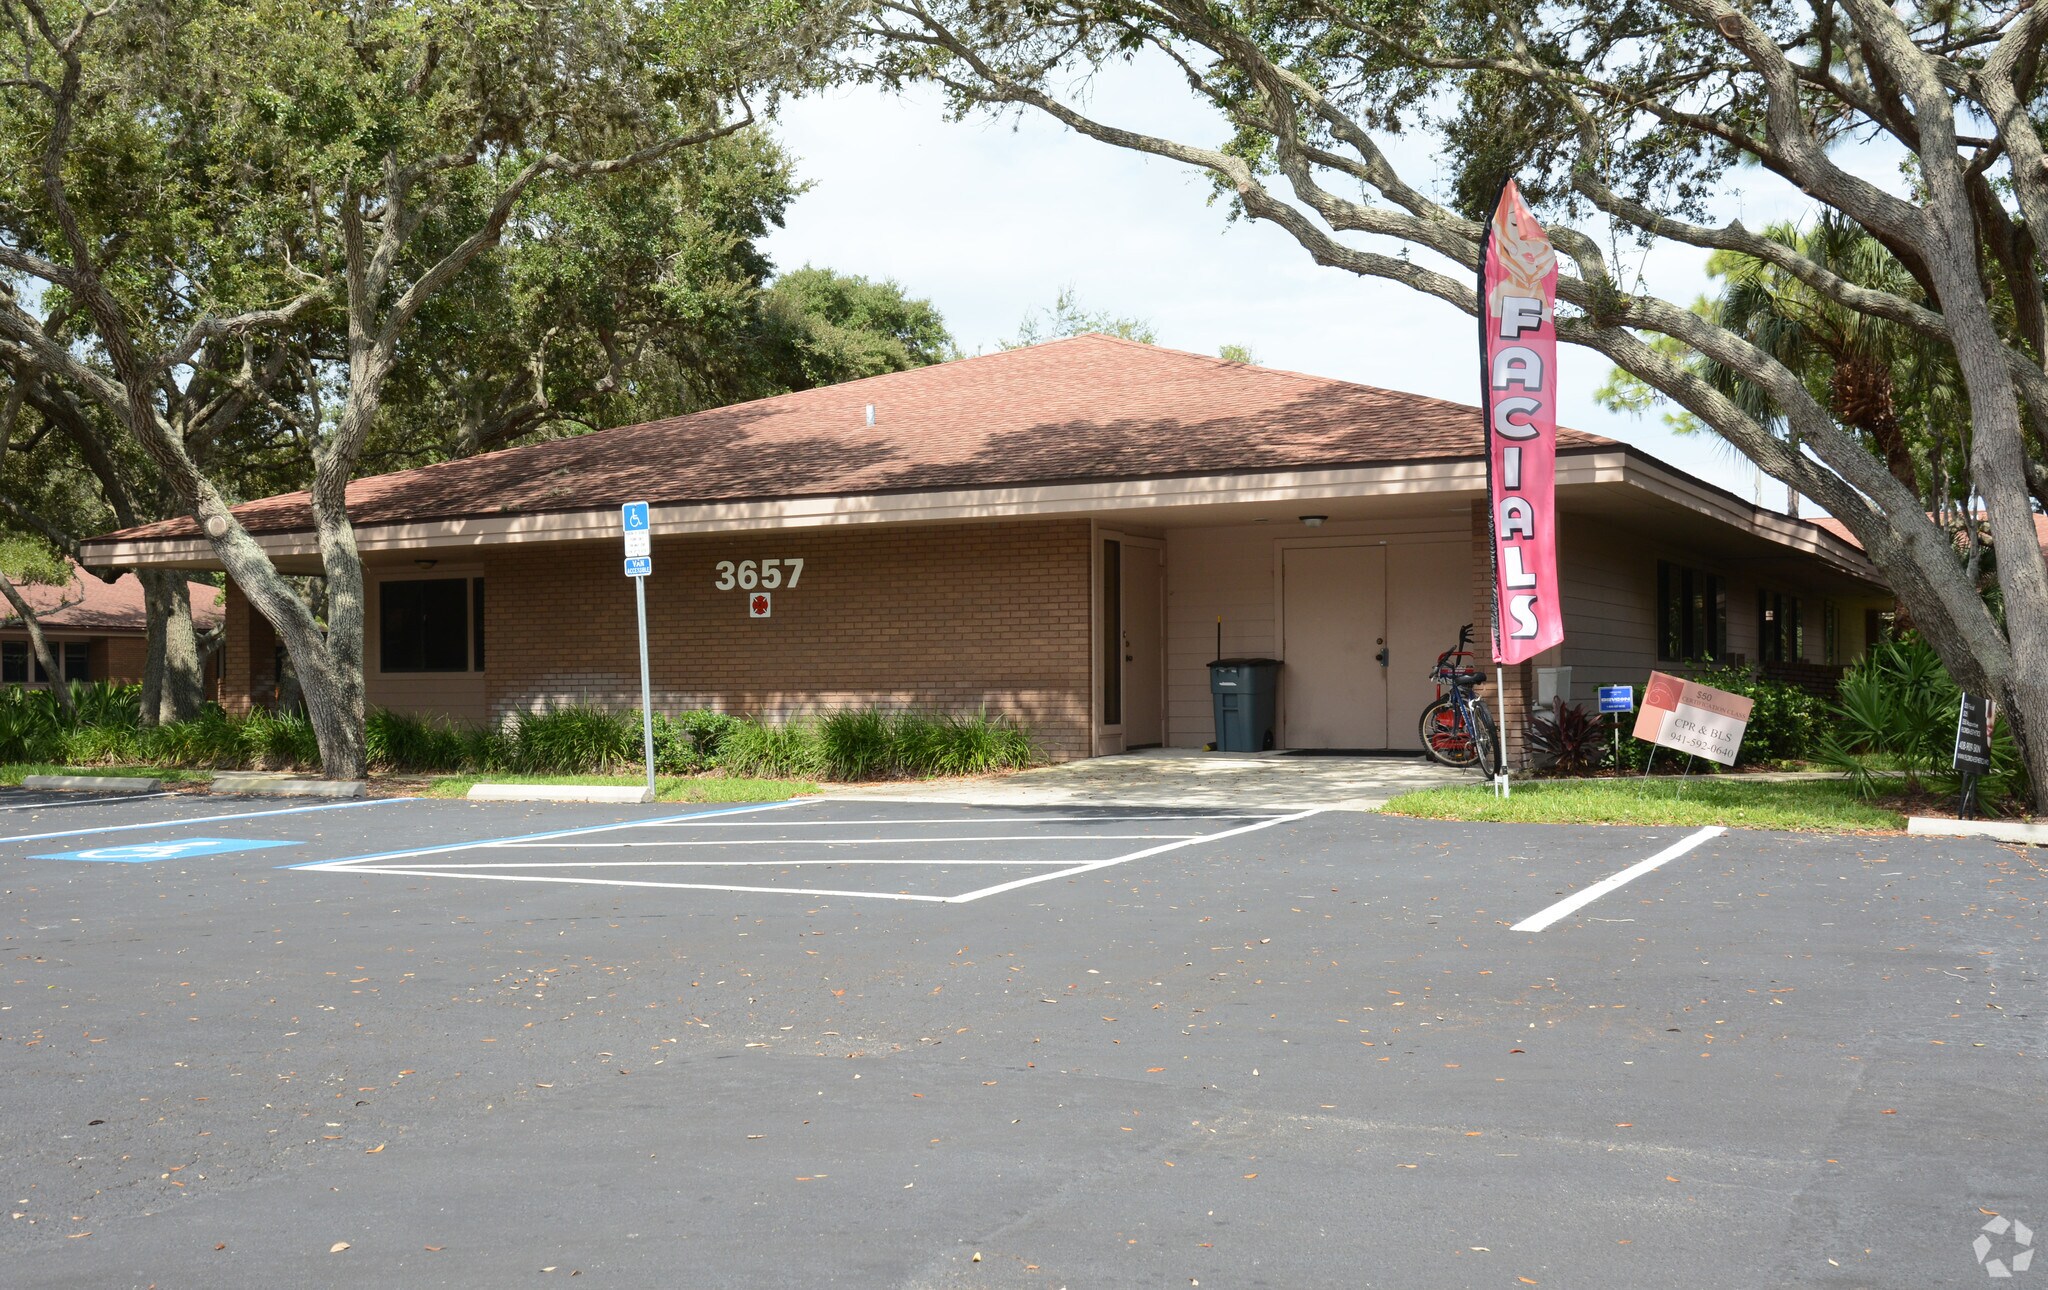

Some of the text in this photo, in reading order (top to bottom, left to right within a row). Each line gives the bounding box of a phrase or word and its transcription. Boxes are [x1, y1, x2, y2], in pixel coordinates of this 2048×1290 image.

[1492, 295, 1543, 640] FACIALS
[627, 566, 650, 574] ACCESSIBLE
[715, 558, 804, 590] 3657
[1681, 696, 1746, 719] CERTIFICATION CLASS
[1696, 690, 1713, 702] $50
[1674, 718, 1733, 742] CPR & BLS
[1670, 732, 1734, 758] 941-592-0640
